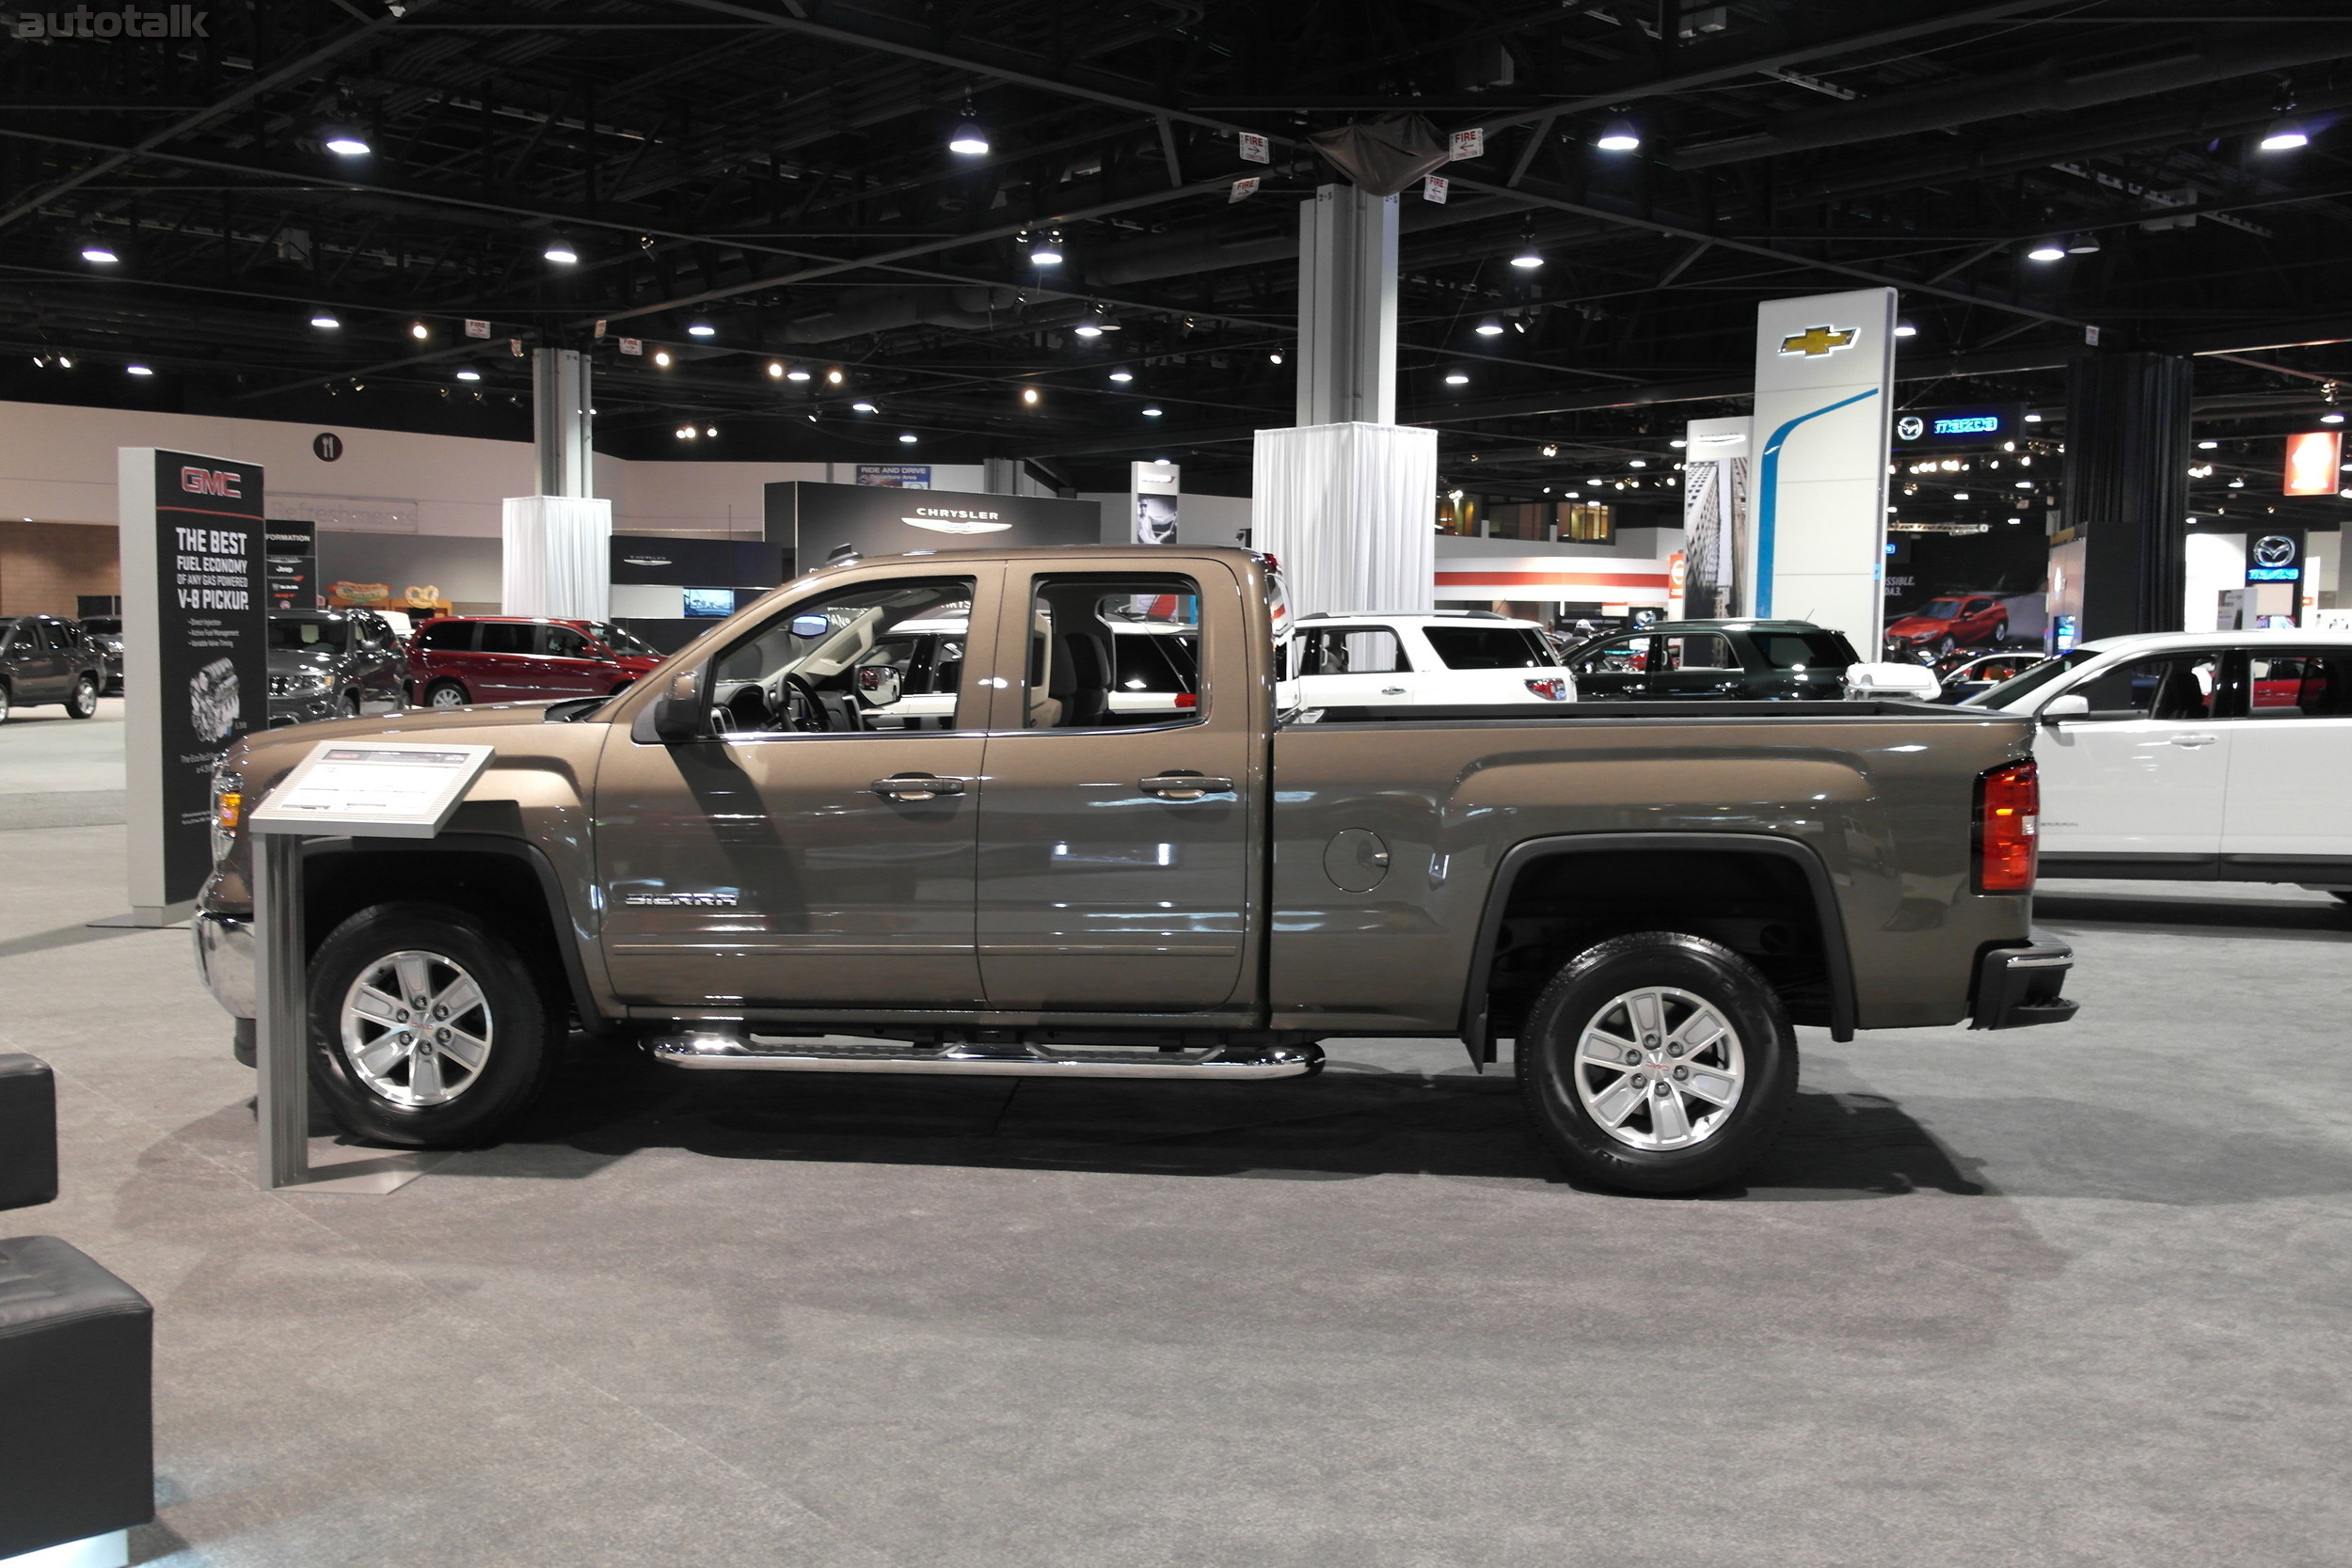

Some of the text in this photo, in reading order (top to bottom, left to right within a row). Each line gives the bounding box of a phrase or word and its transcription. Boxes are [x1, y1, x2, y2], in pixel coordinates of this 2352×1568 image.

[1245, 135, 1264, 147] FIRE
[1454, 130, 1476, 143] FIRE
[1237, 179, 1255, 190] FIRE
[1429, 176, 1444, 188] FIRE
[1934, 416, 1998, 434] mazda
[181, 466, 242, 499] GMC
[270, 500, 416, 527] Refreshments
[915, 507, 999, 520] CHRYSLER
[175, 527, 247, 555] THE BEST
[177, 555, 247, 575] FUEL ECONOMY
[177, 574, 248, 588] OF ANY GAS POWERED
[178, 588, 249, 610] V-8 PICKUP.
[625, 893, 739, 907] SIERRA
